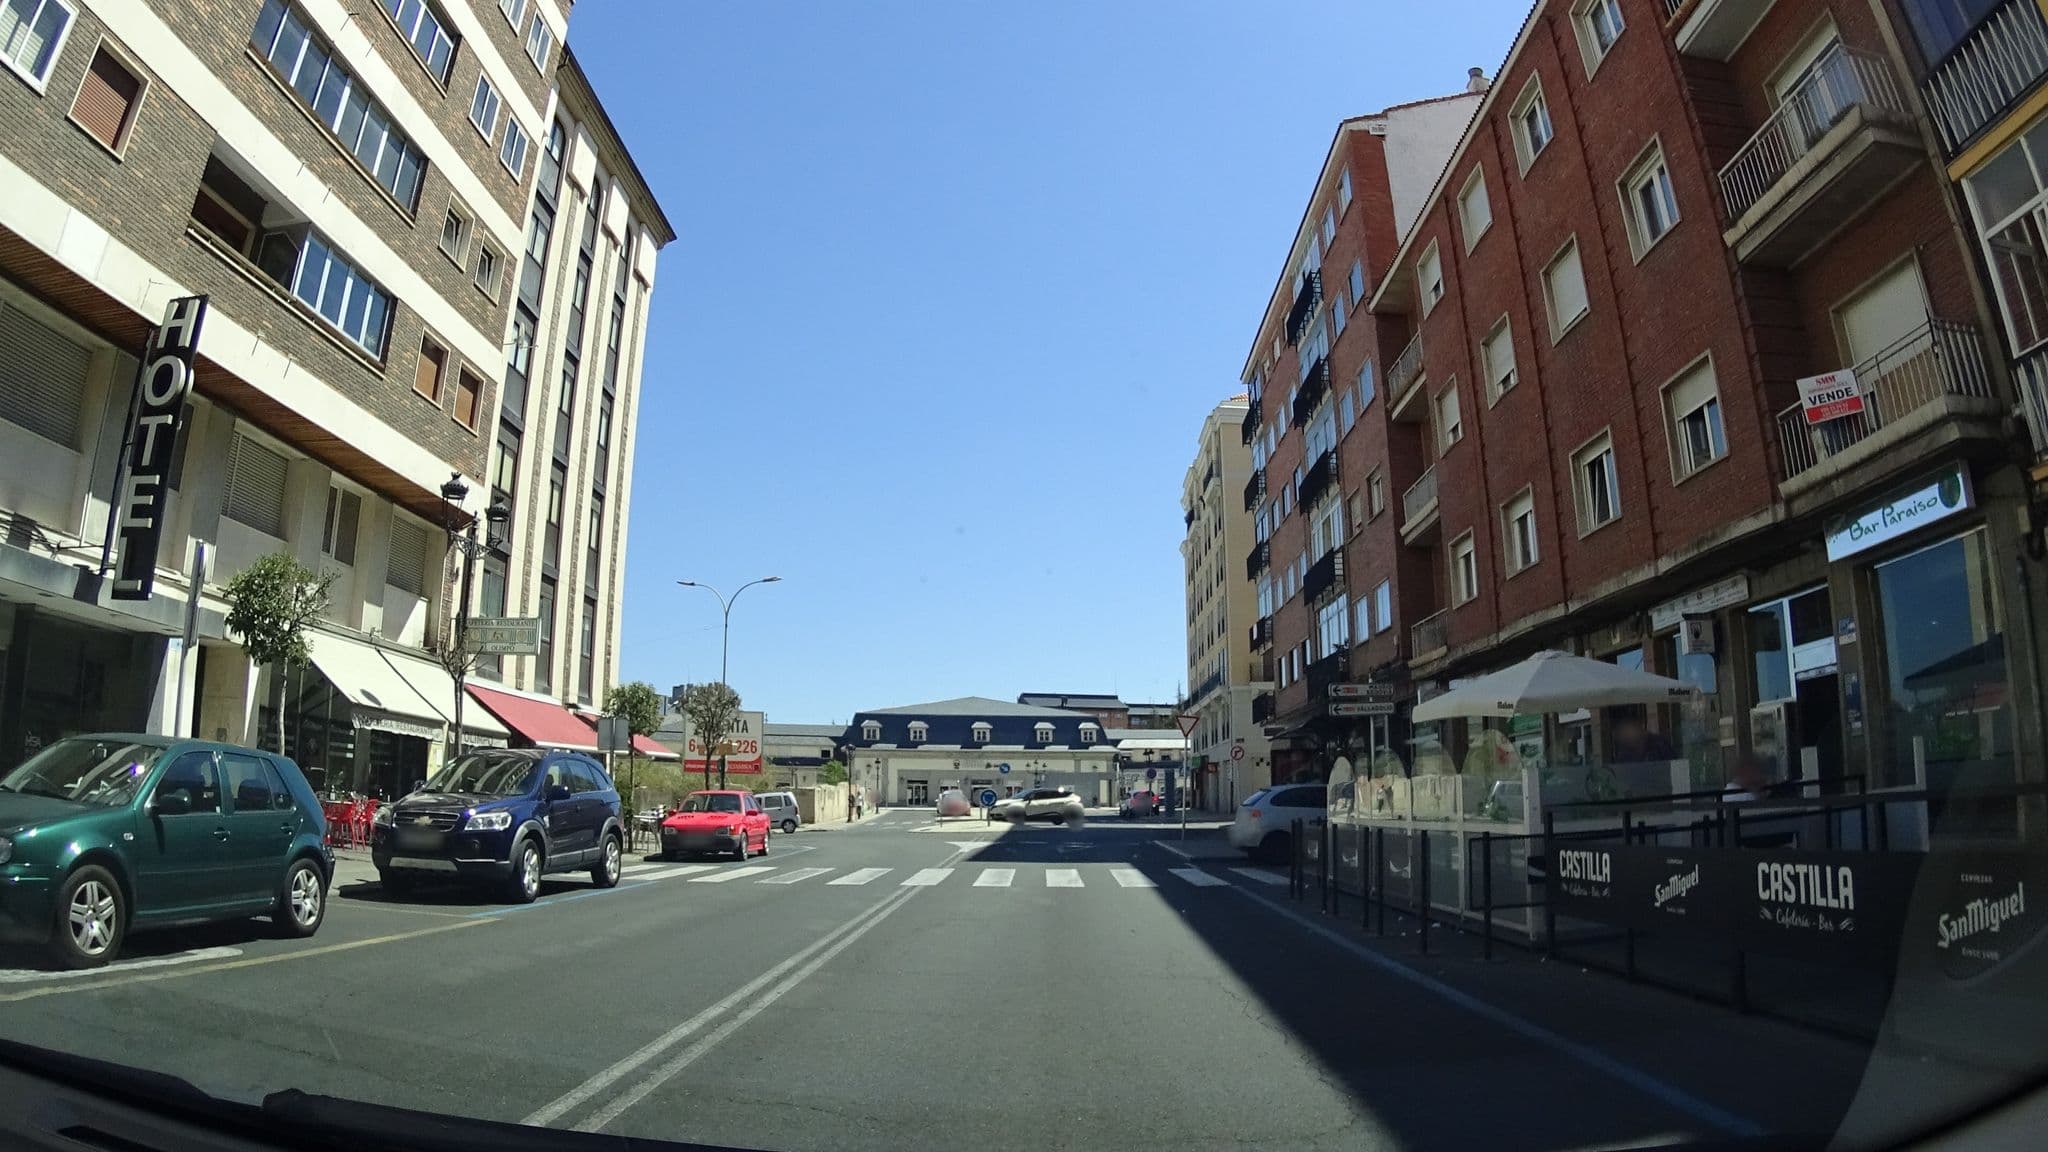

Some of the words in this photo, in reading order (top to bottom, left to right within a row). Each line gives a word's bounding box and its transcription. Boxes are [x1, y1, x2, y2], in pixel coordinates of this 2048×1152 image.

[1808, 387, 1854, 406] VENDE
[111, 298, 200, 592] HOTEL
[1849, 519, 1879, 541] Bar
[736, 740, 757, 753] 226
[1560, 850, 1610, 883] CASTILLA
[1757, 862, 1854, 910] CASTILLA
